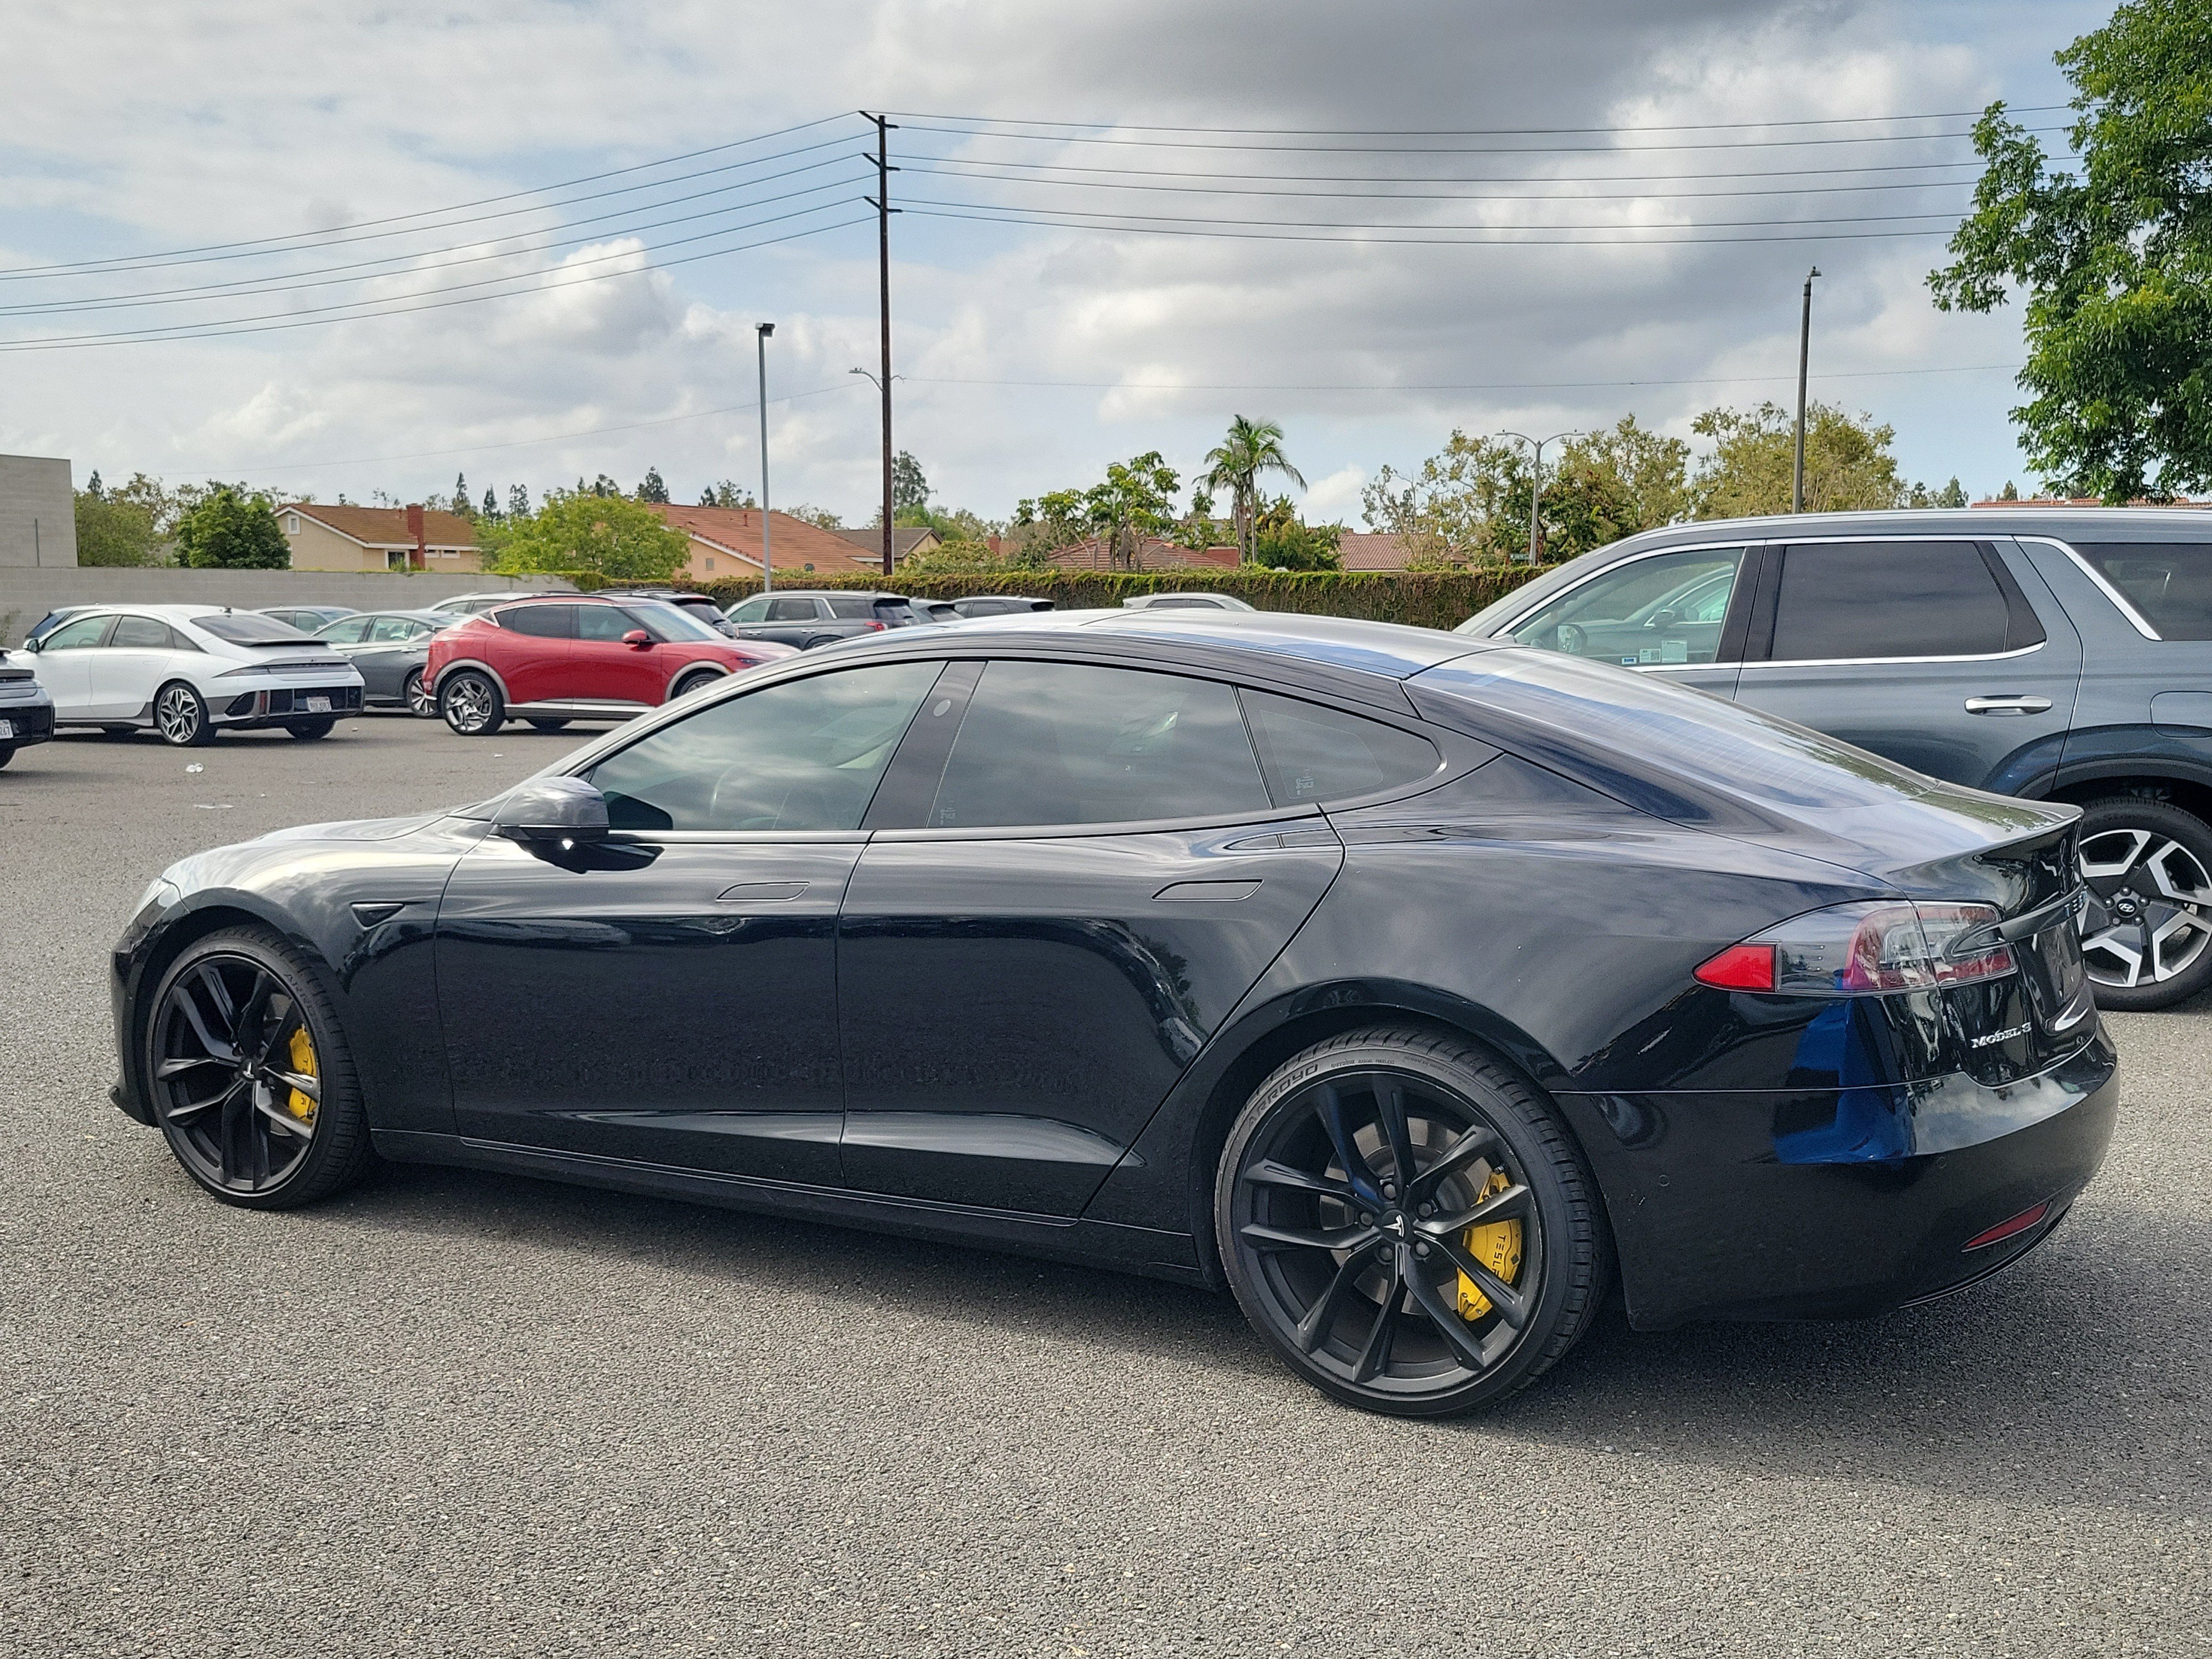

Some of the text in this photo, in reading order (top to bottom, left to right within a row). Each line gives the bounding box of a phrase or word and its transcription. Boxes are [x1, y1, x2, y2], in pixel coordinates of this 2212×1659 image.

[1971, 1022, 2032, 1048] MODEL S
[1249, 1064, 1318, 1131] ARROYO
